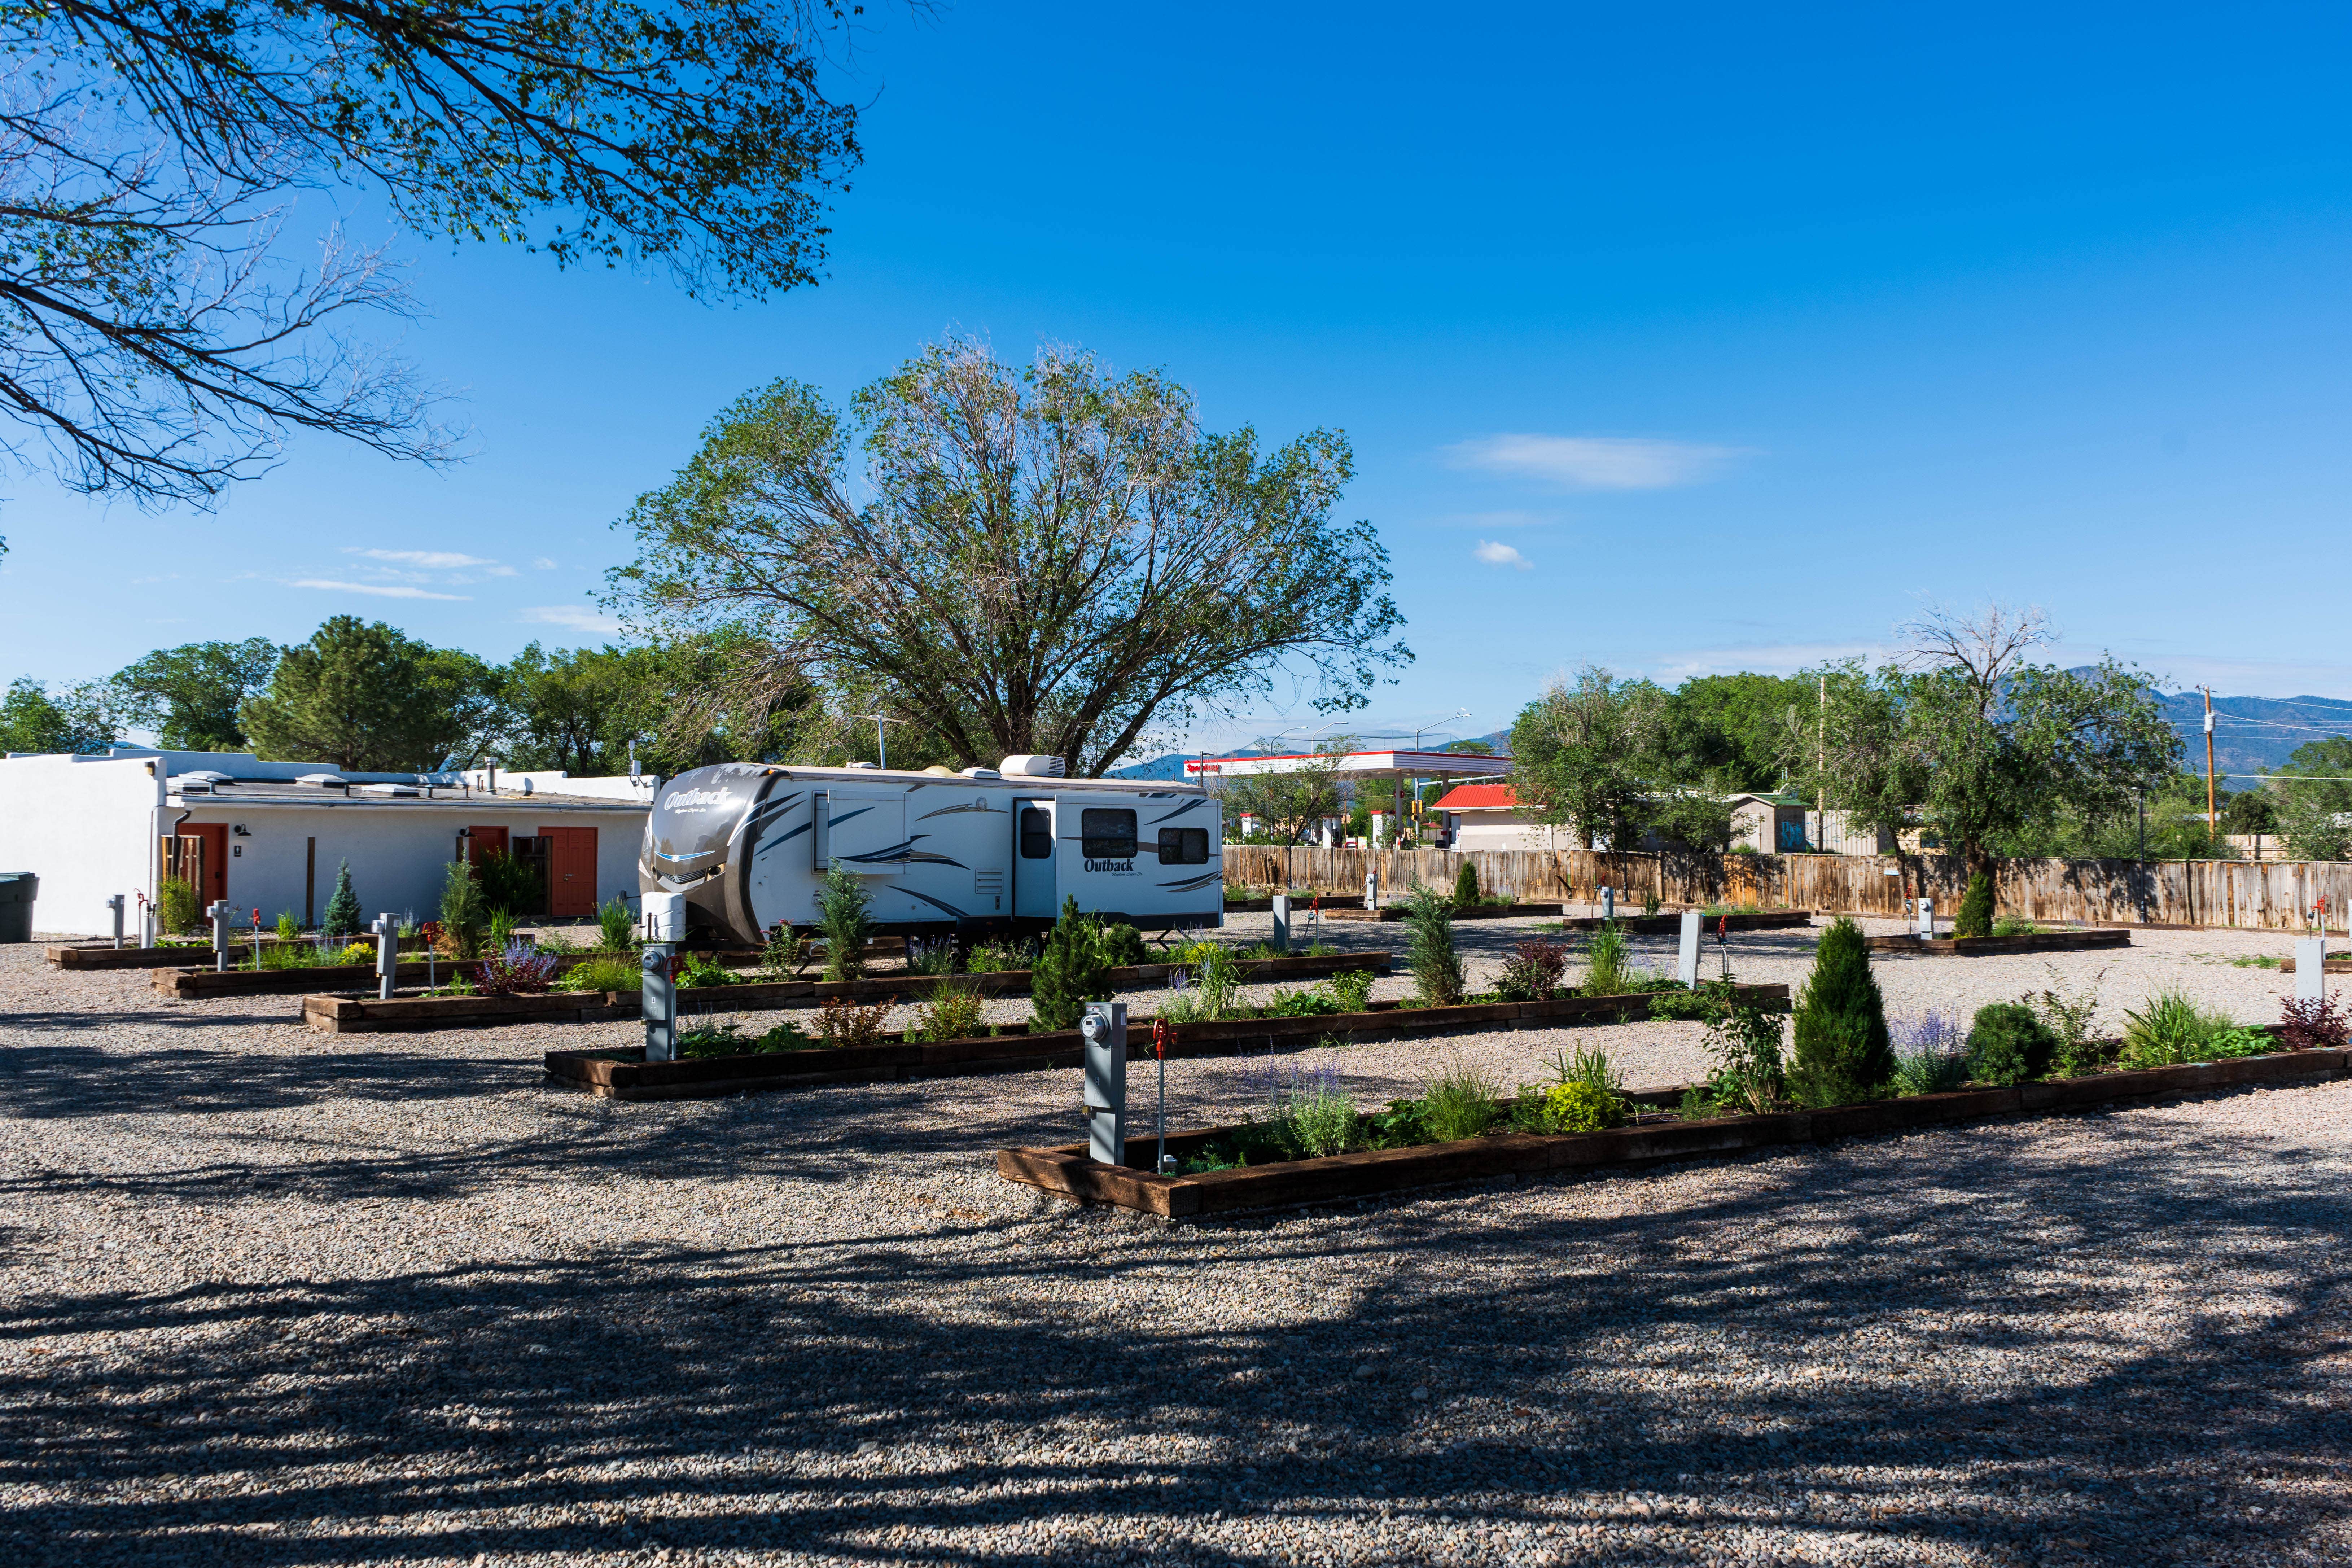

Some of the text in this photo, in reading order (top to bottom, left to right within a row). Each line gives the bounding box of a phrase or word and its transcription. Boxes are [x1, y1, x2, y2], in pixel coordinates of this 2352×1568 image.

[664, 787, 733, 810] Outback
[1084, 858, 1134, 872] Outback
[1095, 1077, 1099, 1085] 5
